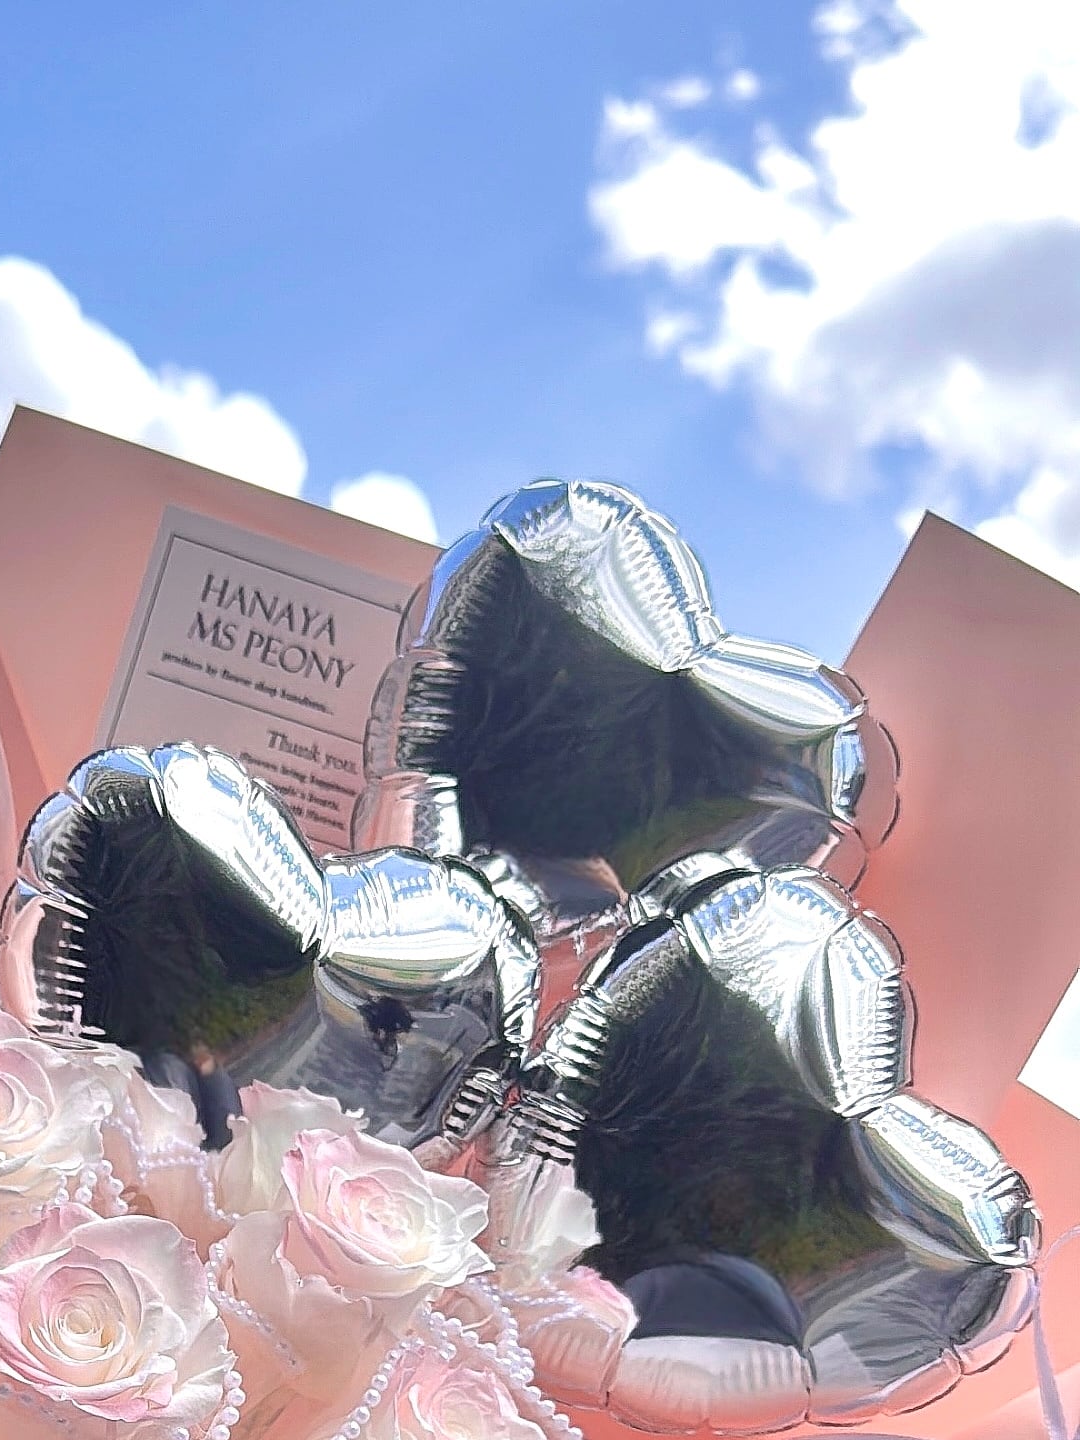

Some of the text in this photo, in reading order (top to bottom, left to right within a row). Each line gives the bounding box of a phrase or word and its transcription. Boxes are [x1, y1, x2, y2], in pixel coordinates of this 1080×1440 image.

[201, 574, 336, 646] HANAYA
[187, 611, 356, 689] MS PEONY
[267, 729, 320, 762] Thank
